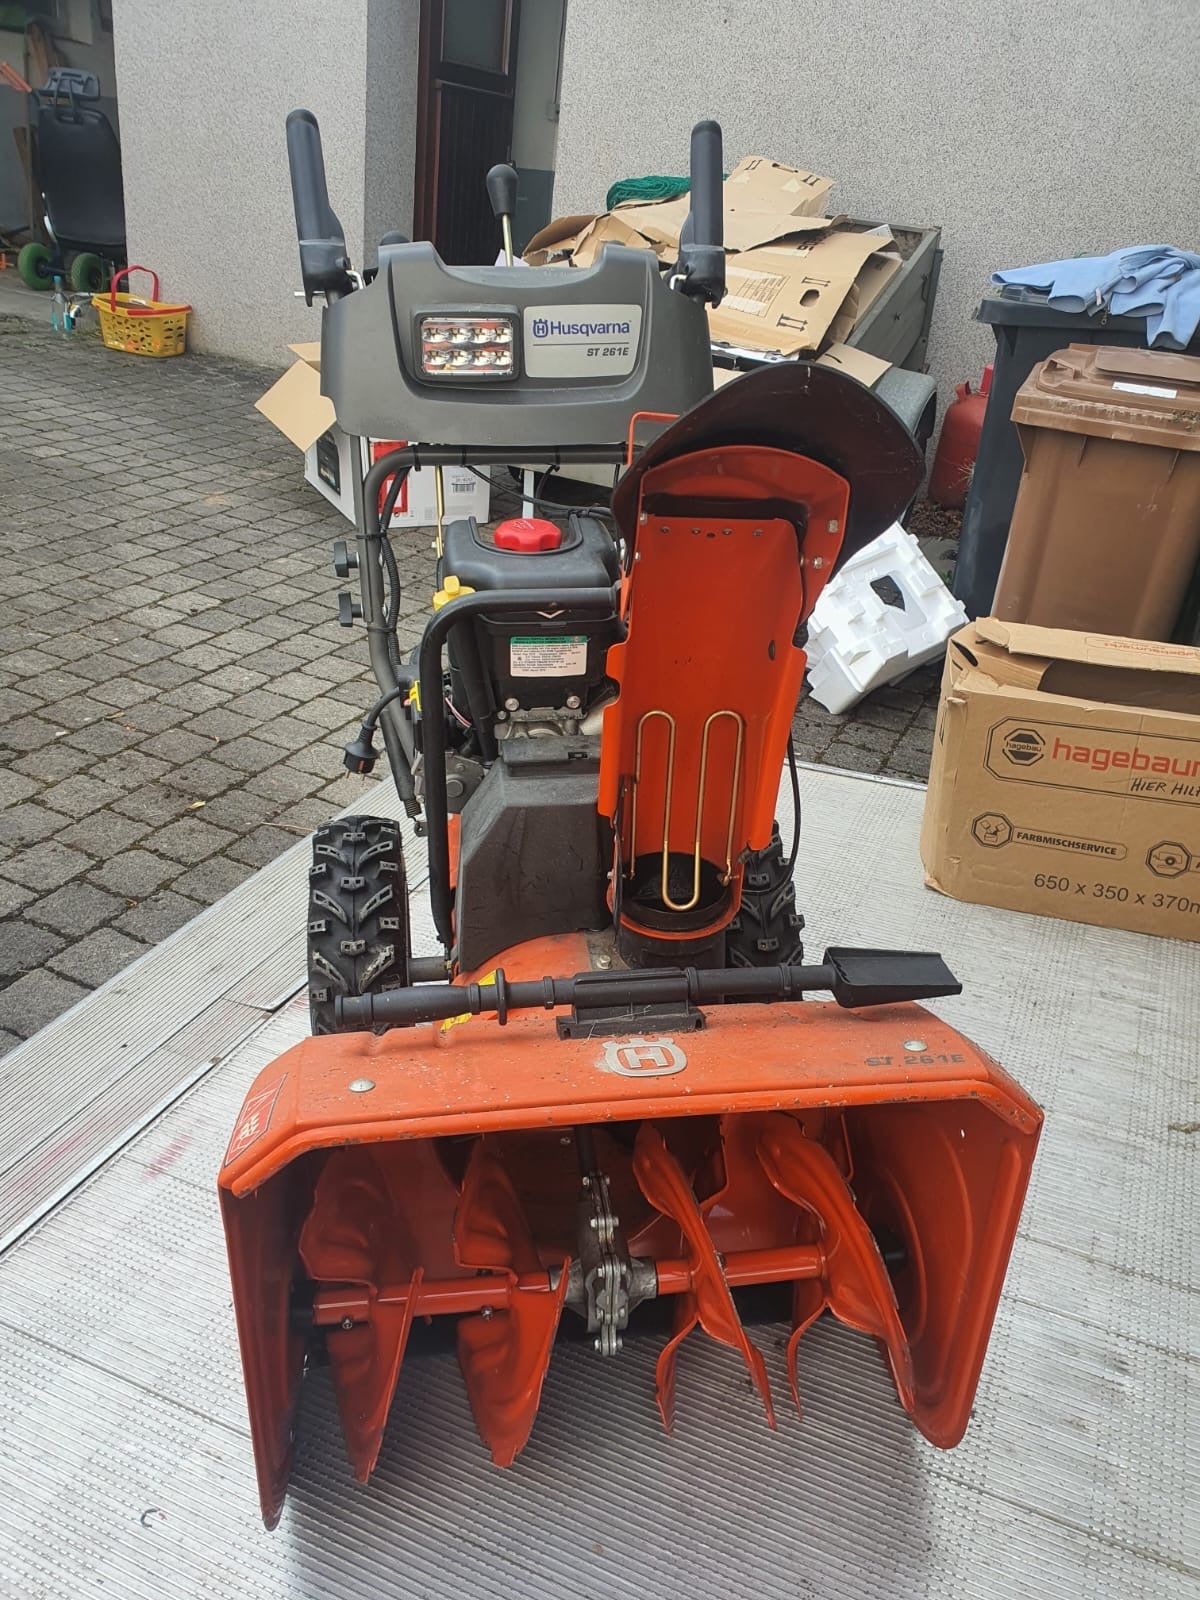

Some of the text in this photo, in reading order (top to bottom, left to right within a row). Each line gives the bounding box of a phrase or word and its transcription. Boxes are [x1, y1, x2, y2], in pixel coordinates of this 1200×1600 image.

[550, 321, 630, 336] Husqvarna
[586, 347, 630, 357] ST 261E
[1006, 741, 1042, 753] hagebau
[1130, 778, 1168, 793] HIER
[1016, 832, 1117, 855] FARBMISCHSERVICE
[1033, 873, 1070, 892] 650
[1074, 882, 1087, 895] x
[1092, 883, 1129, 902] 350
[1134, 893, 1146, 905] x
[866, 1054, 966, 1067] ST 261E
